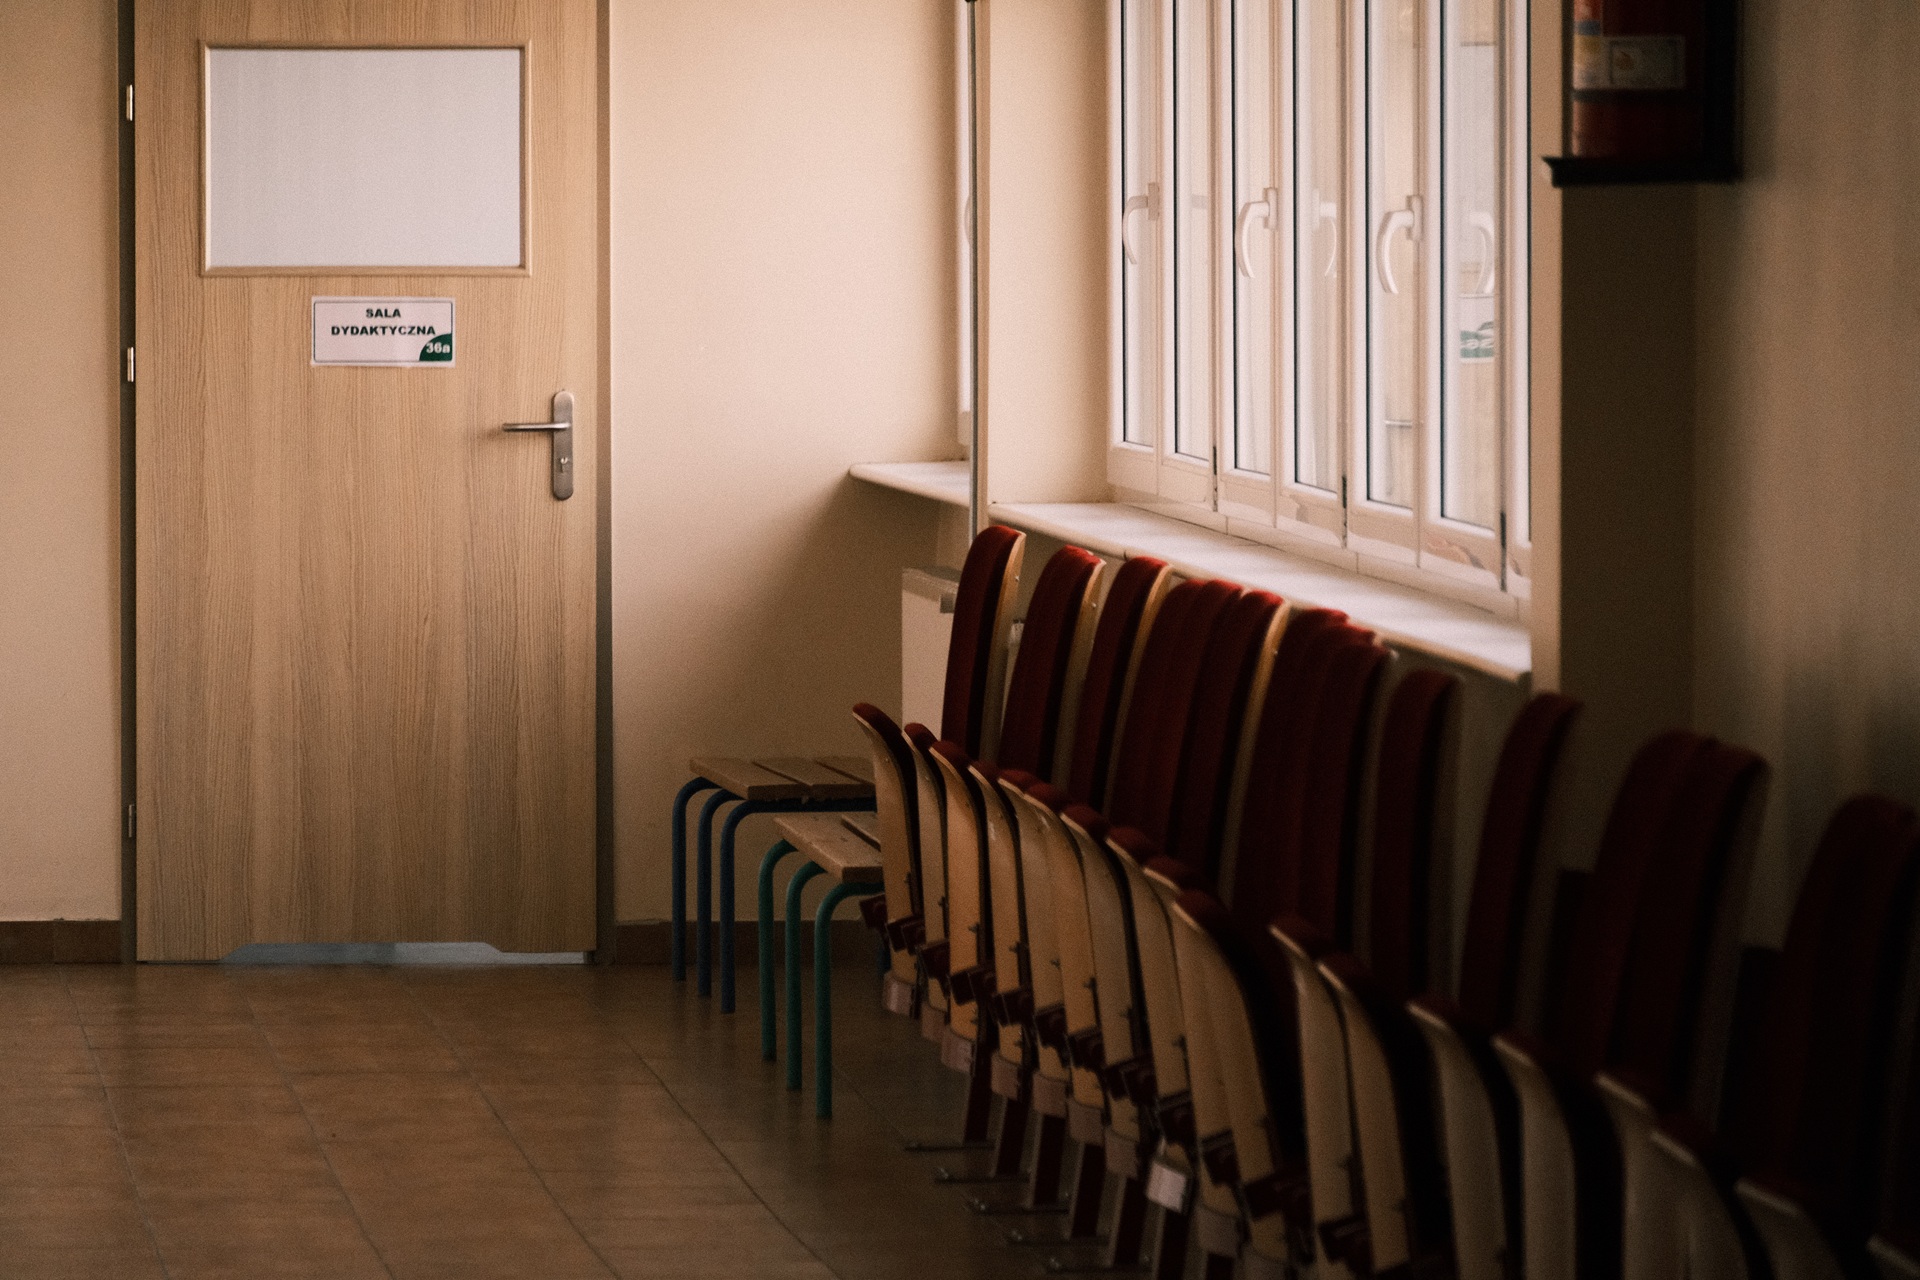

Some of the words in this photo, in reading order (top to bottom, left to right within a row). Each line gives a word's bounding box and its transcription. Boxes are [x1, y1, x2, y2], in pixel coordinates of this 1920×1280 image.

[366, 308, 401, 318] SALA
[331, 326, 436, 335] DYDAKTYCZNA
[426, 341, 451, 354] 36a
